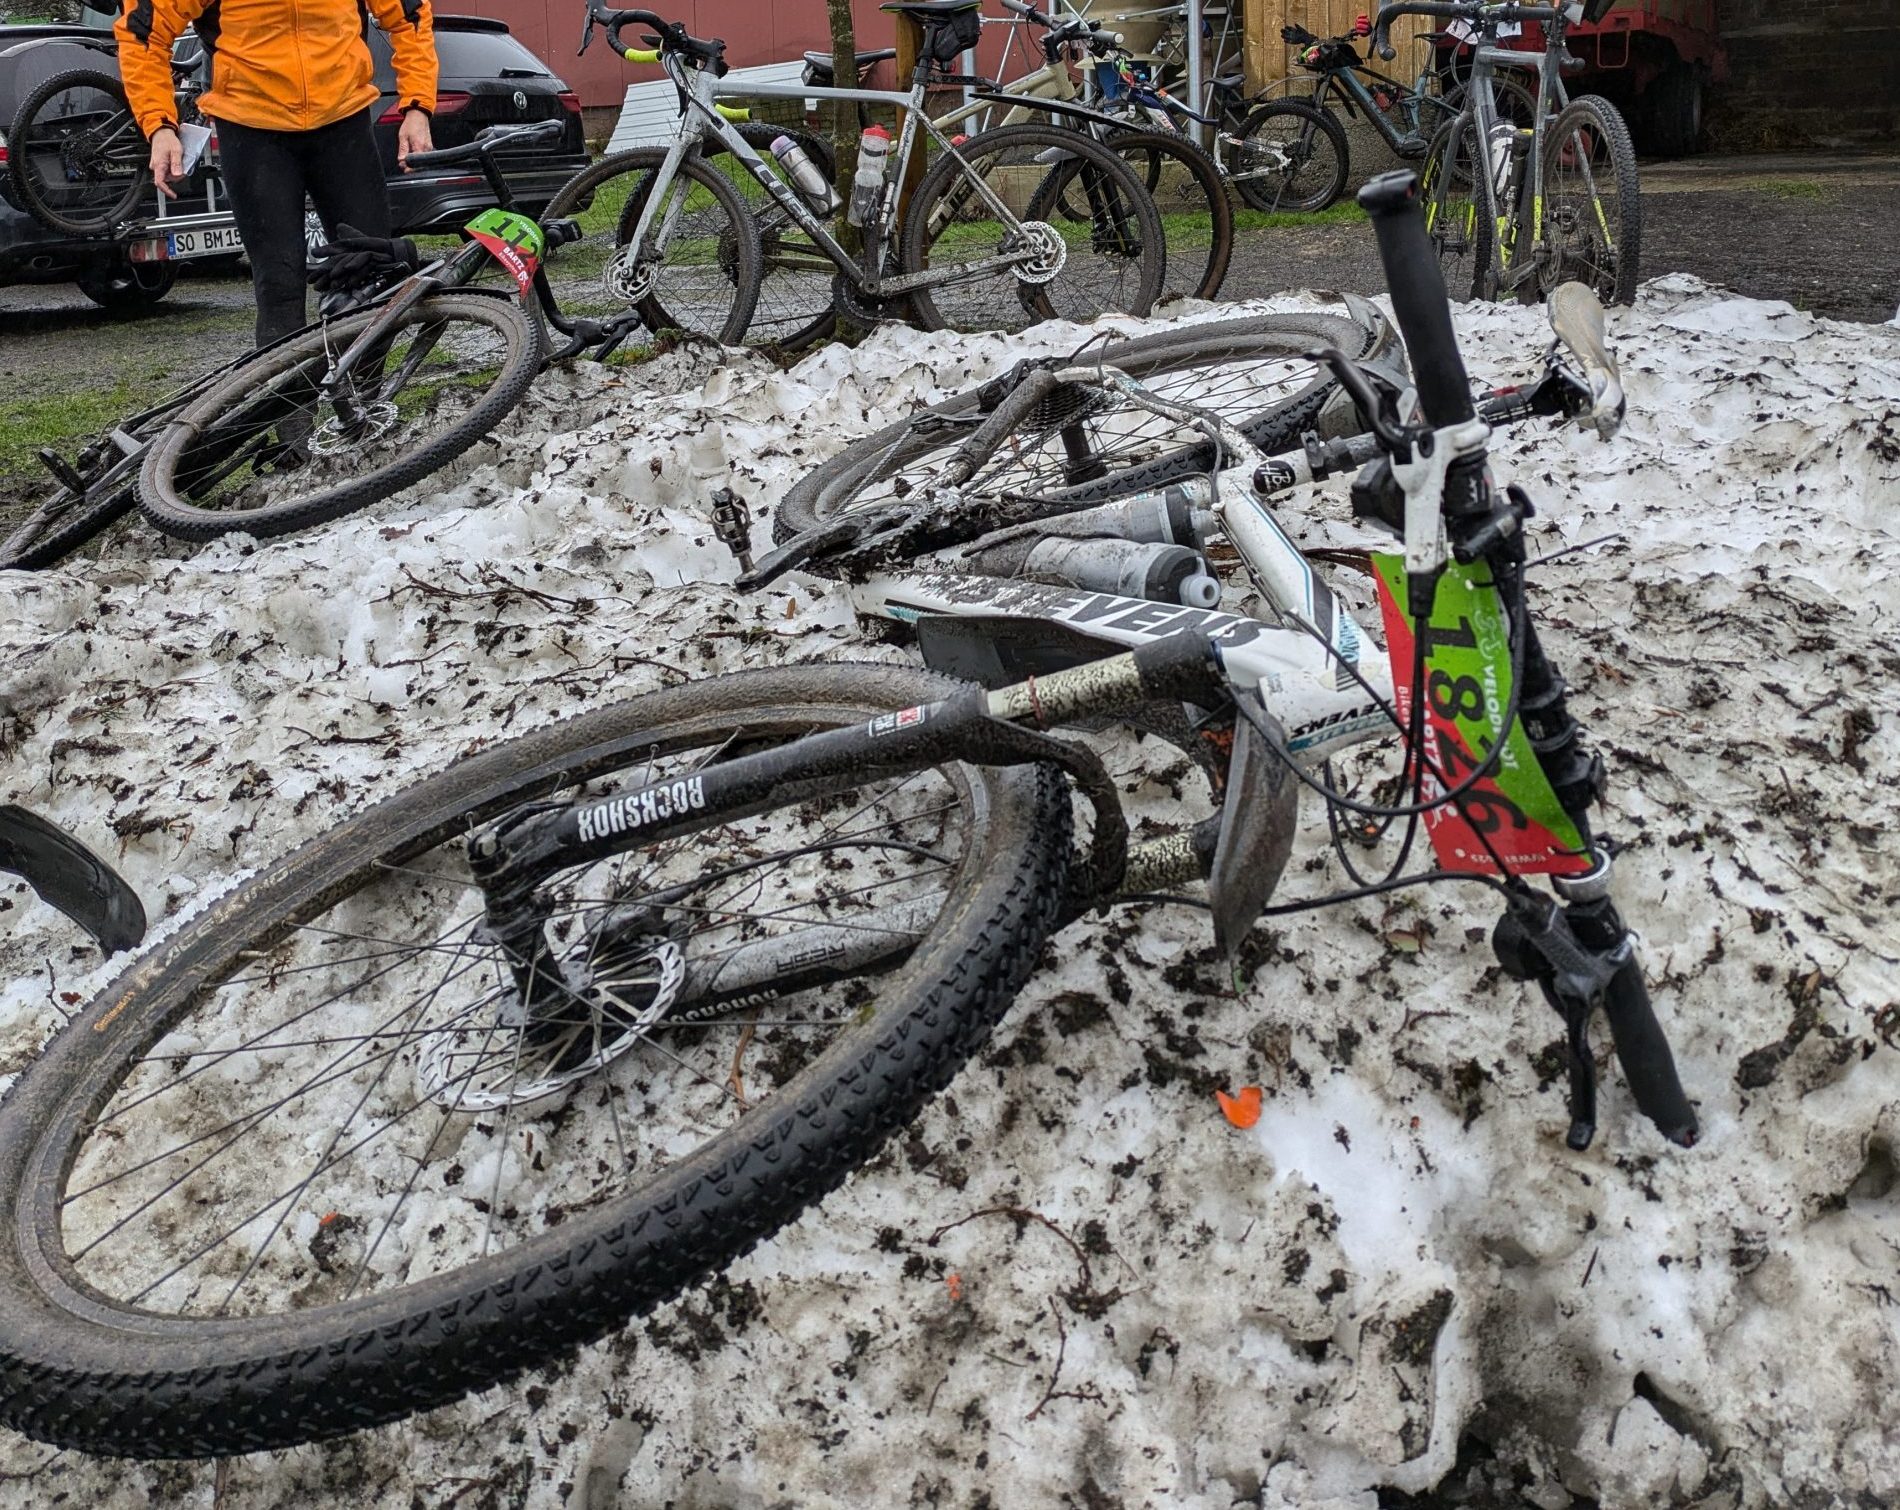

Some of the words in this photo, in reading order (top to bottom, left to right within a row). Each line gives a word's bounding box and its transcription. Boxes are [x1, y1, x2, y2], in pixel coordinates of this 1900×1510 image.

[175, 233, 195, 252] SO
[502, 246, 525, 271] BARTZ
[1290, 699, 1397, 739] TEVENS
[1424, 614, 1528, 833] 1826
[1482, 664, 1519, 770] VELODEOT
[577, 775, 706, 842] ROCKSHOX
